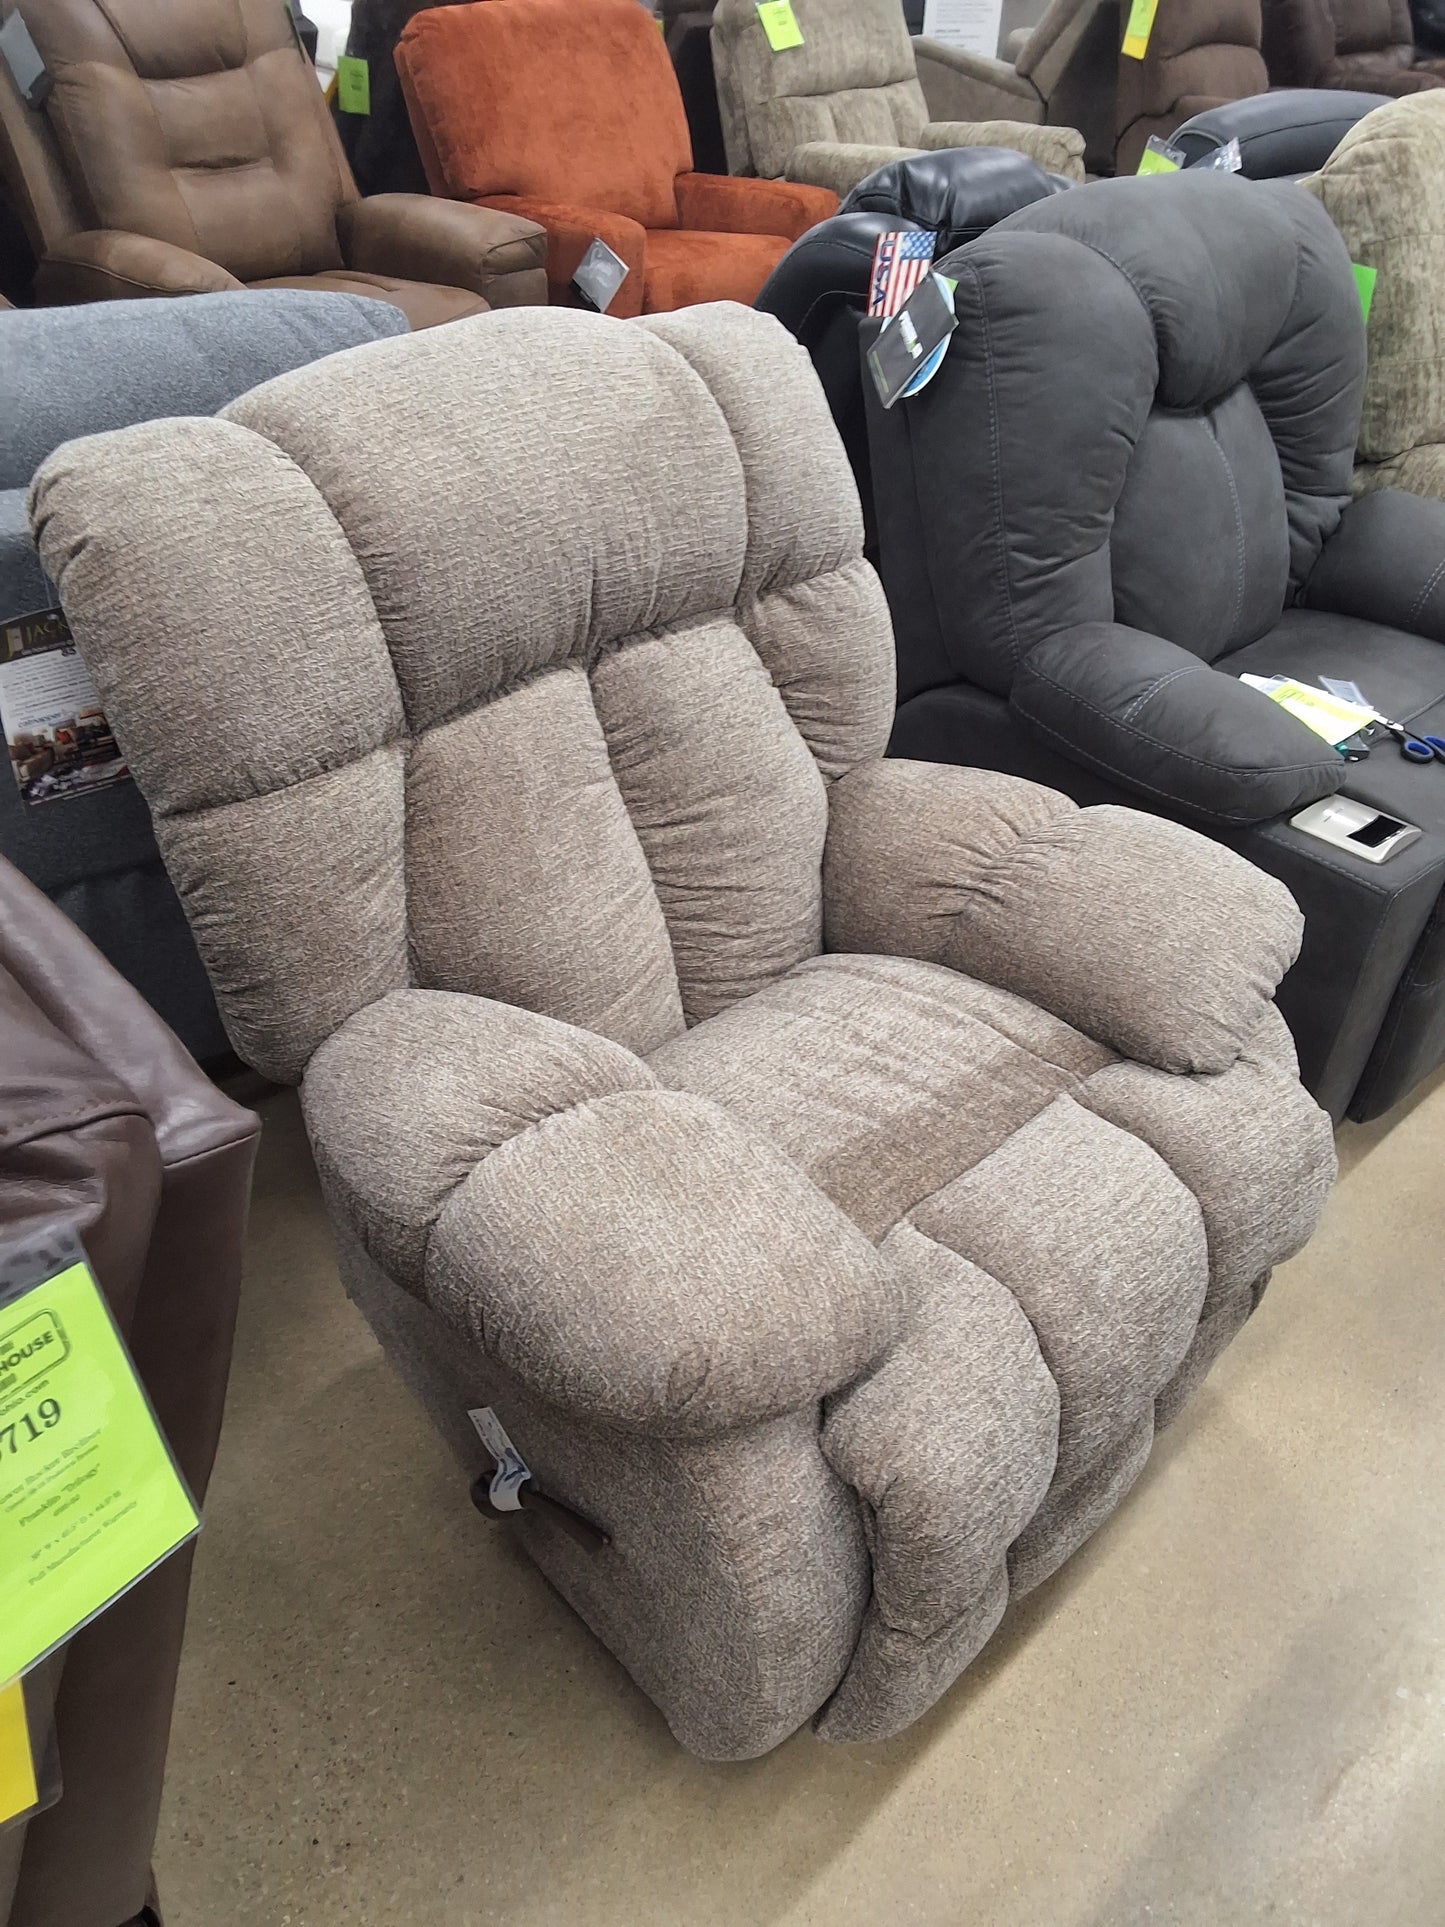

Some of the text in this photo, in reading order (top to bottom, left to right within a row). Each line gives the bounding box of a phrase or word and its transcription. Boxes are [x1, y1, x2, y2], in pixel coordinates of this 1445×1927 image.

[872, 240, 895, 306] USA
[0, 1330, 55, 1376] HOUSE
[0, 1398, 61, 1462] 719
